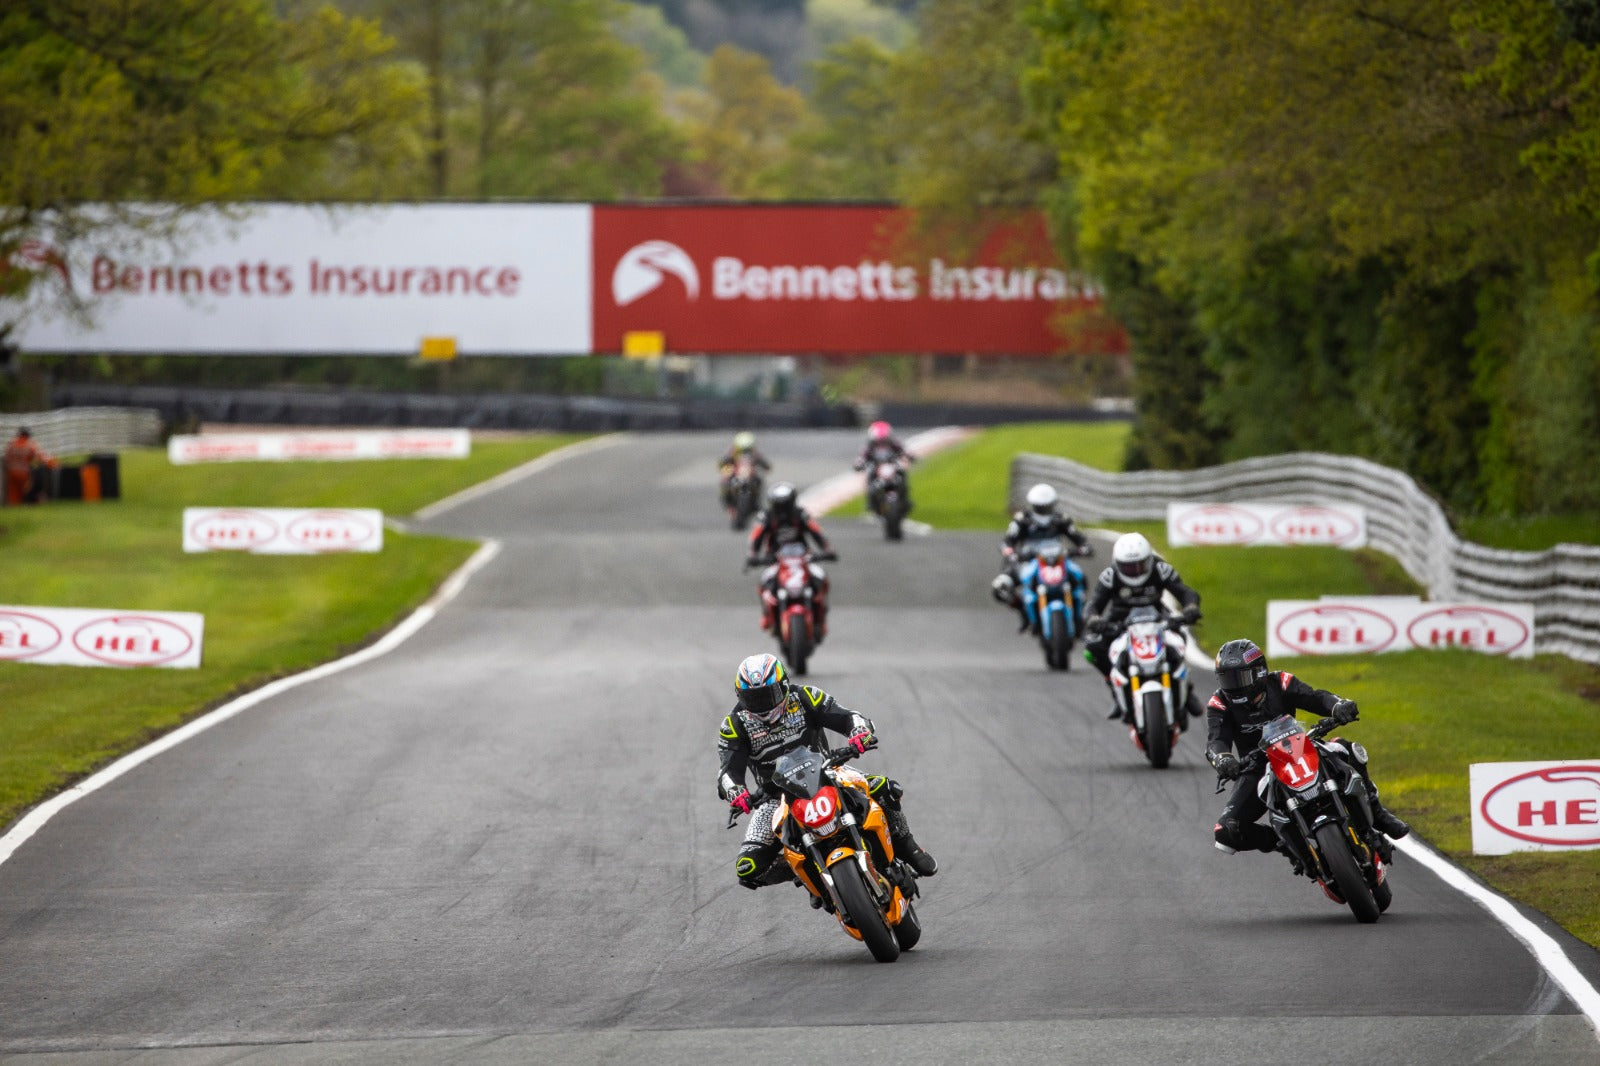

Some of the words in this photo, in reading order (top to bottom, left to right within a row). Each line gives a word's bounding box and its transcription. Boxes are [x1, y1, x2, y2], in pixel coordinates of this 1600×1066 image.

[92, 256, 293, 296] Bennetts
[309, 257, 521, 297] Insurance
[713, 256, 918, 300] Bennetts
[95, 634, 170, 654] HEL
[1298, 626, 1375, 645] HEL
[1430, 627, 1506, 648] HEL
[1284, 756, 1314, 784] 11
[804, 796, 831, 823] 40
